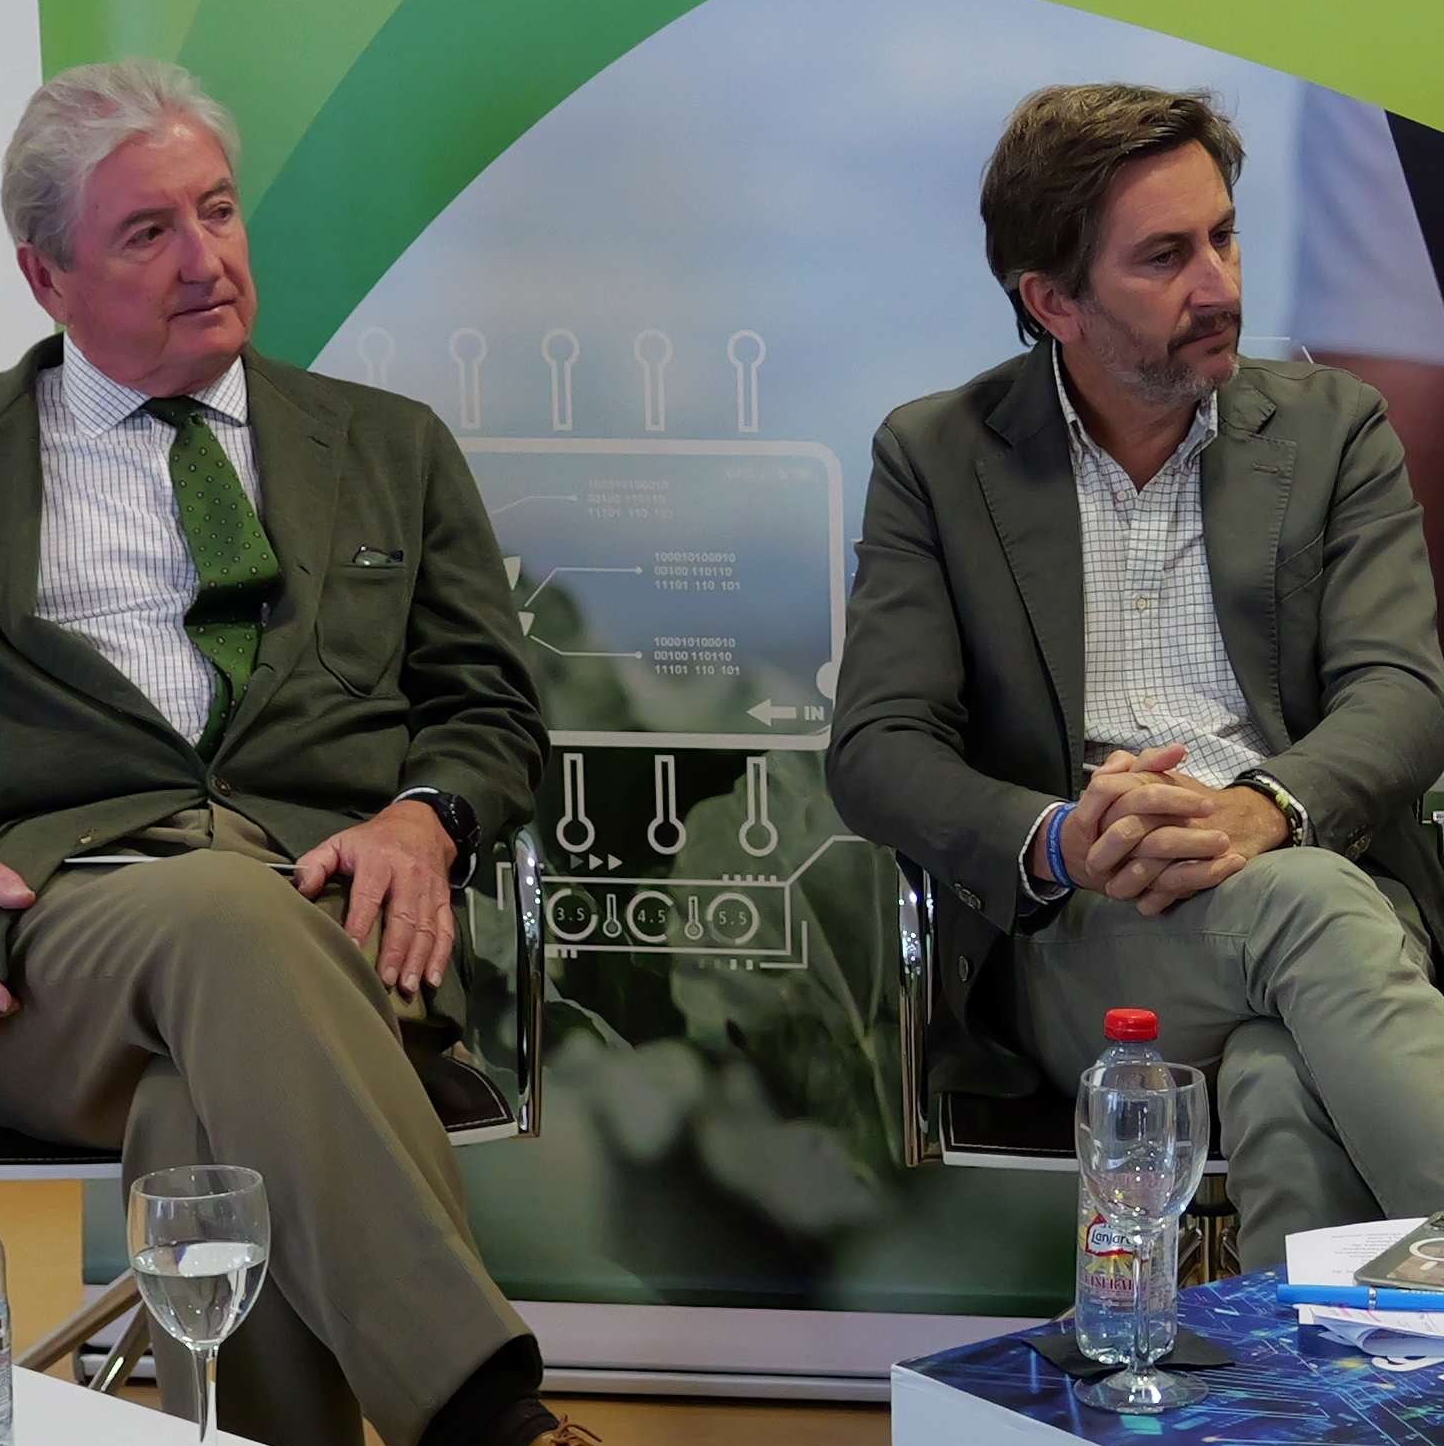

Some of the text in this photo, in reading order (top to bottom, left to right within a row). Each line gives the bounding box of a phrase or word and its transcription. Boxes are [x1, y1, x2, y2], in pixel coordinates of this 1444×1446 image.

[804, 706, 825, 721] IN
[557, 907, 748, 925] 3.5 4.5 5.5
